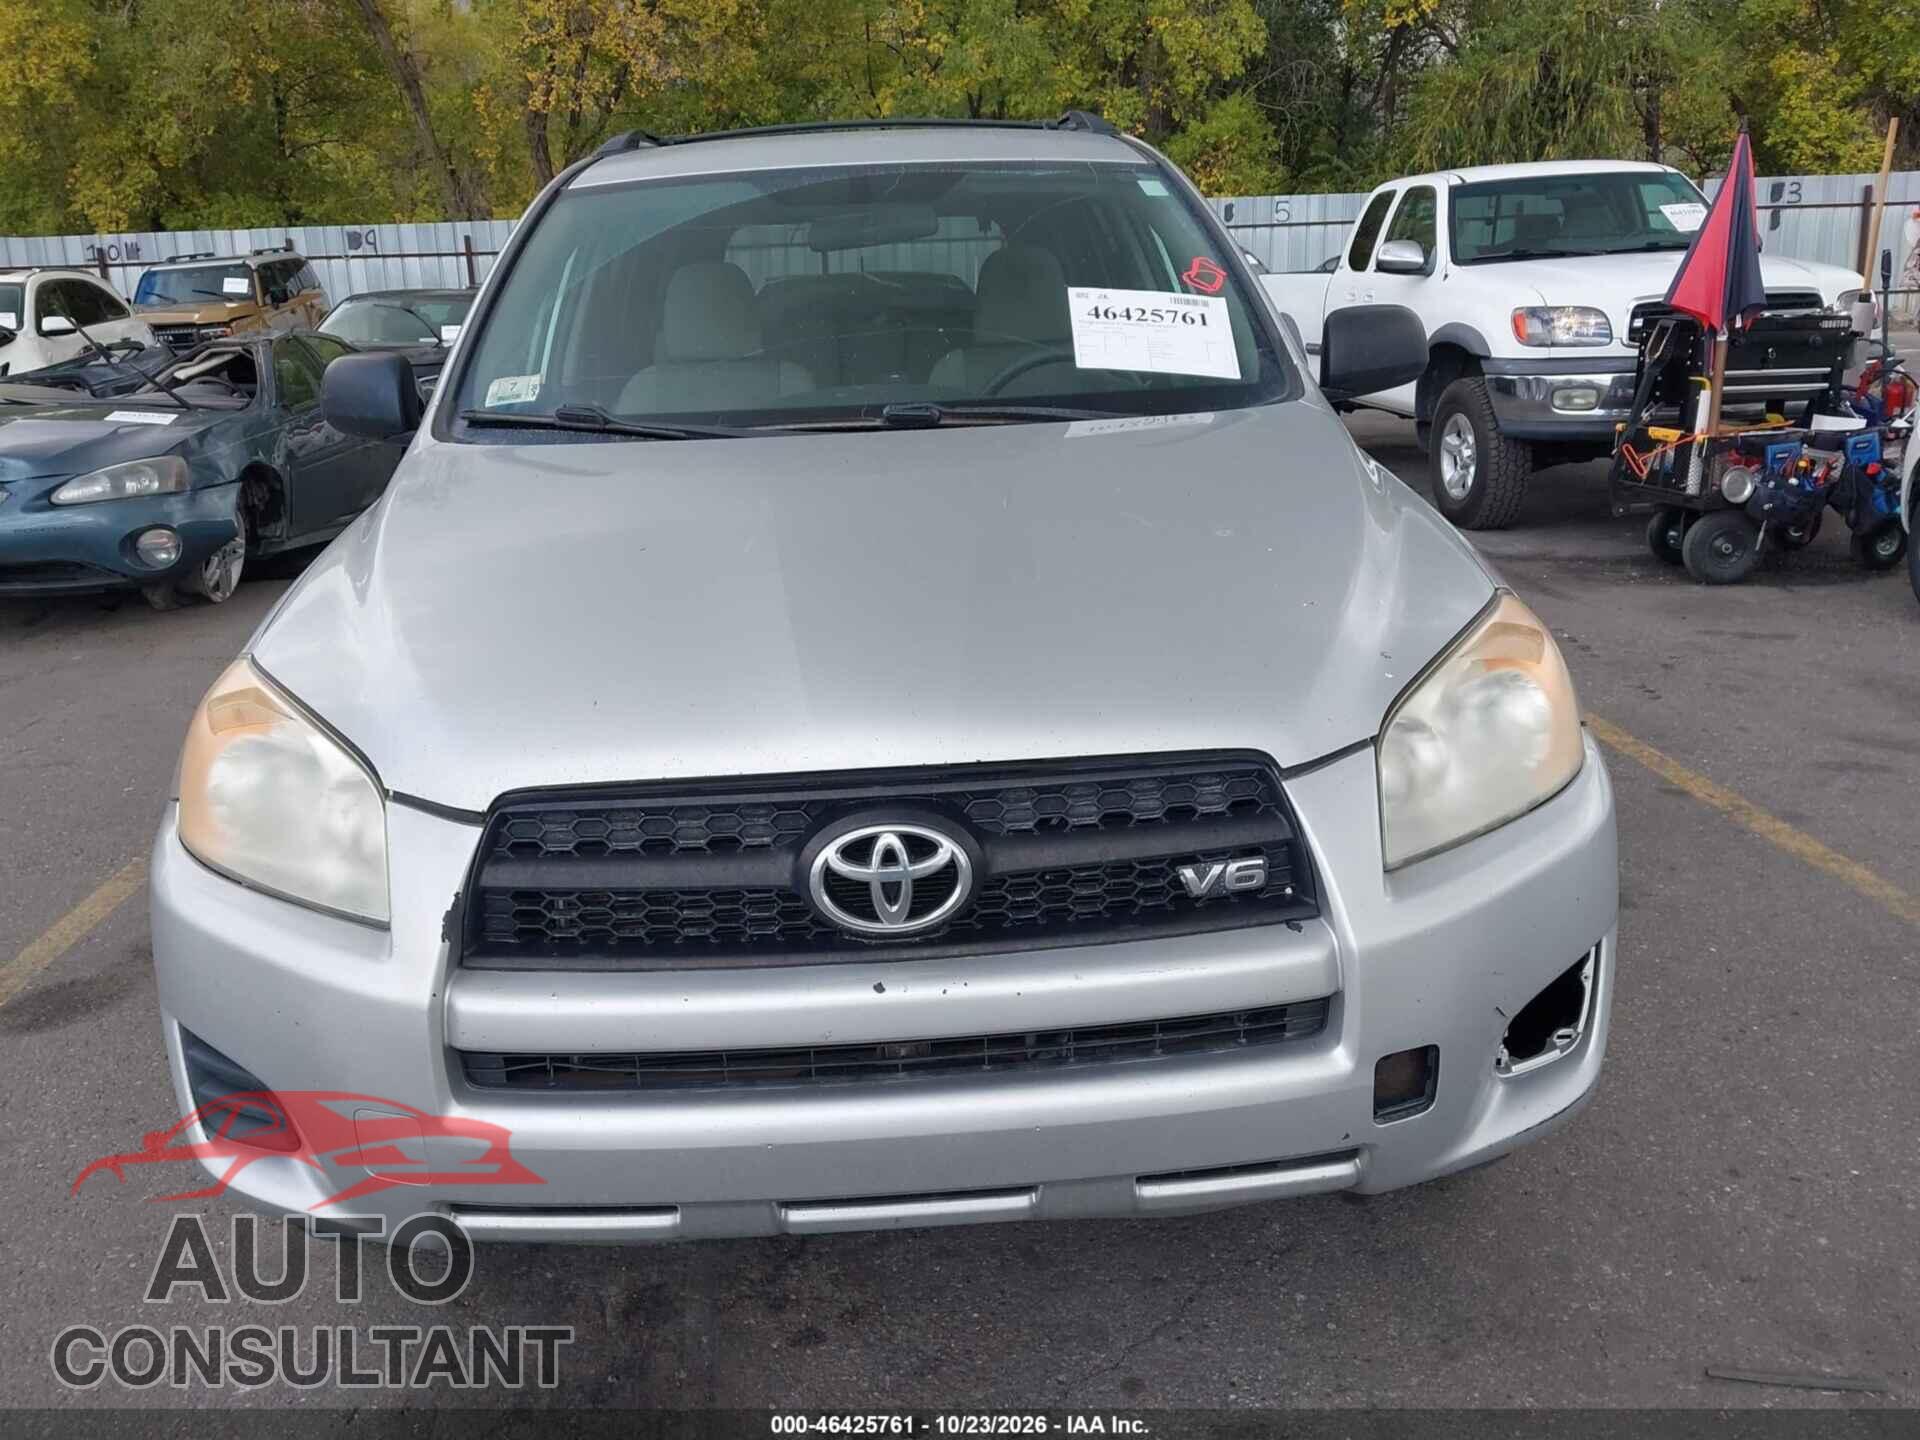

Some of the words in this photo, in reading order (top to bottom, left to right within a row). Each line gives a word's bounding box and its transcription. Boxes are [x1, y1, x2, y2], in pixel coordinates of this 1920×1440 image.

[1275, 200, 1291, 223] 5
[1086, 304, 1209, 327] 46425761
[1177, 857, 1266, 897] V6
